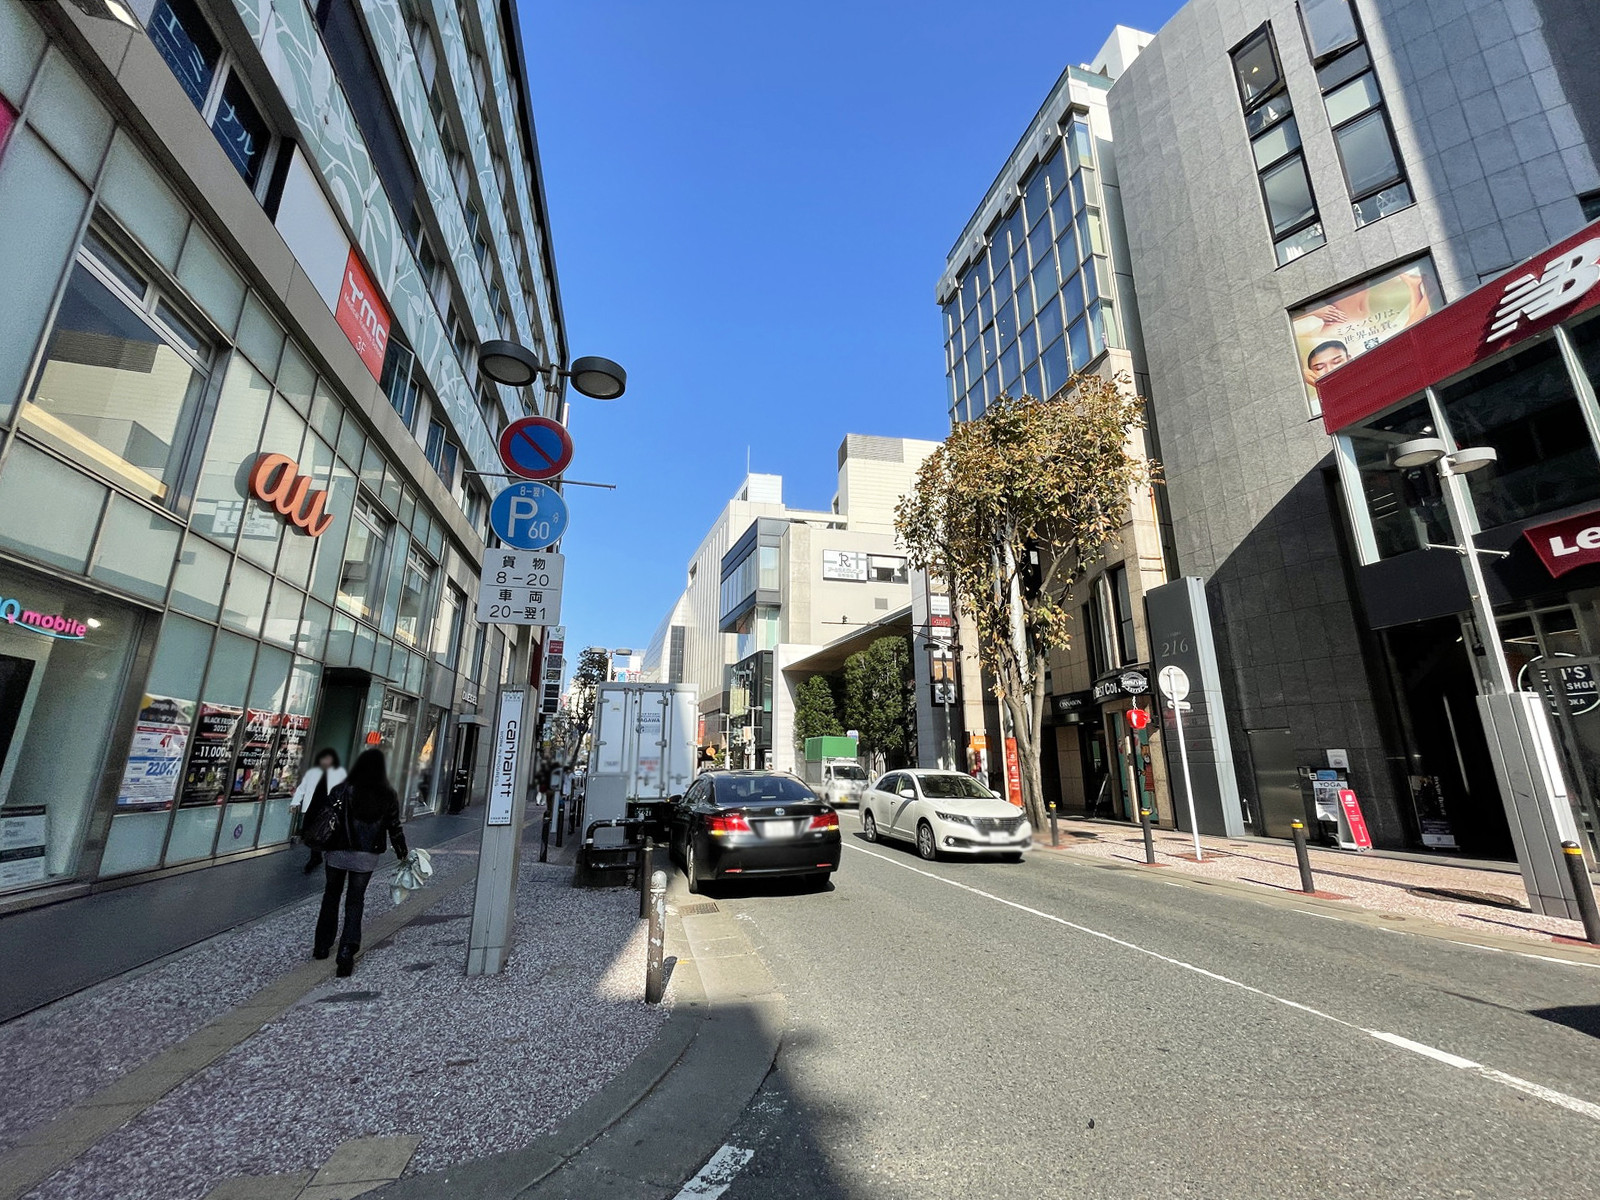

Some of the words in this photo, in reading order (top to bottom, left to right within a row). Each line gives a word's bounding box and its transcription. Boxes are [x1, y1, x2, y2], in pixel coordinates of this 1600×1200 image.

[159, 3, 255, 156] エミナル
[250, 453, 334, 537] au
[508, 496, 539, 538] P
[528, 521, 550, 541] 60
[498, 588, 543, 603] 車両
[0, 596, 20, 624] Q
[22, 611, 87, 637] mobile
[1162, 637, 1189, 658] 216
[1566, 680, 1596, 691] SHOP
[500, 720, 517, 797] carhartt
